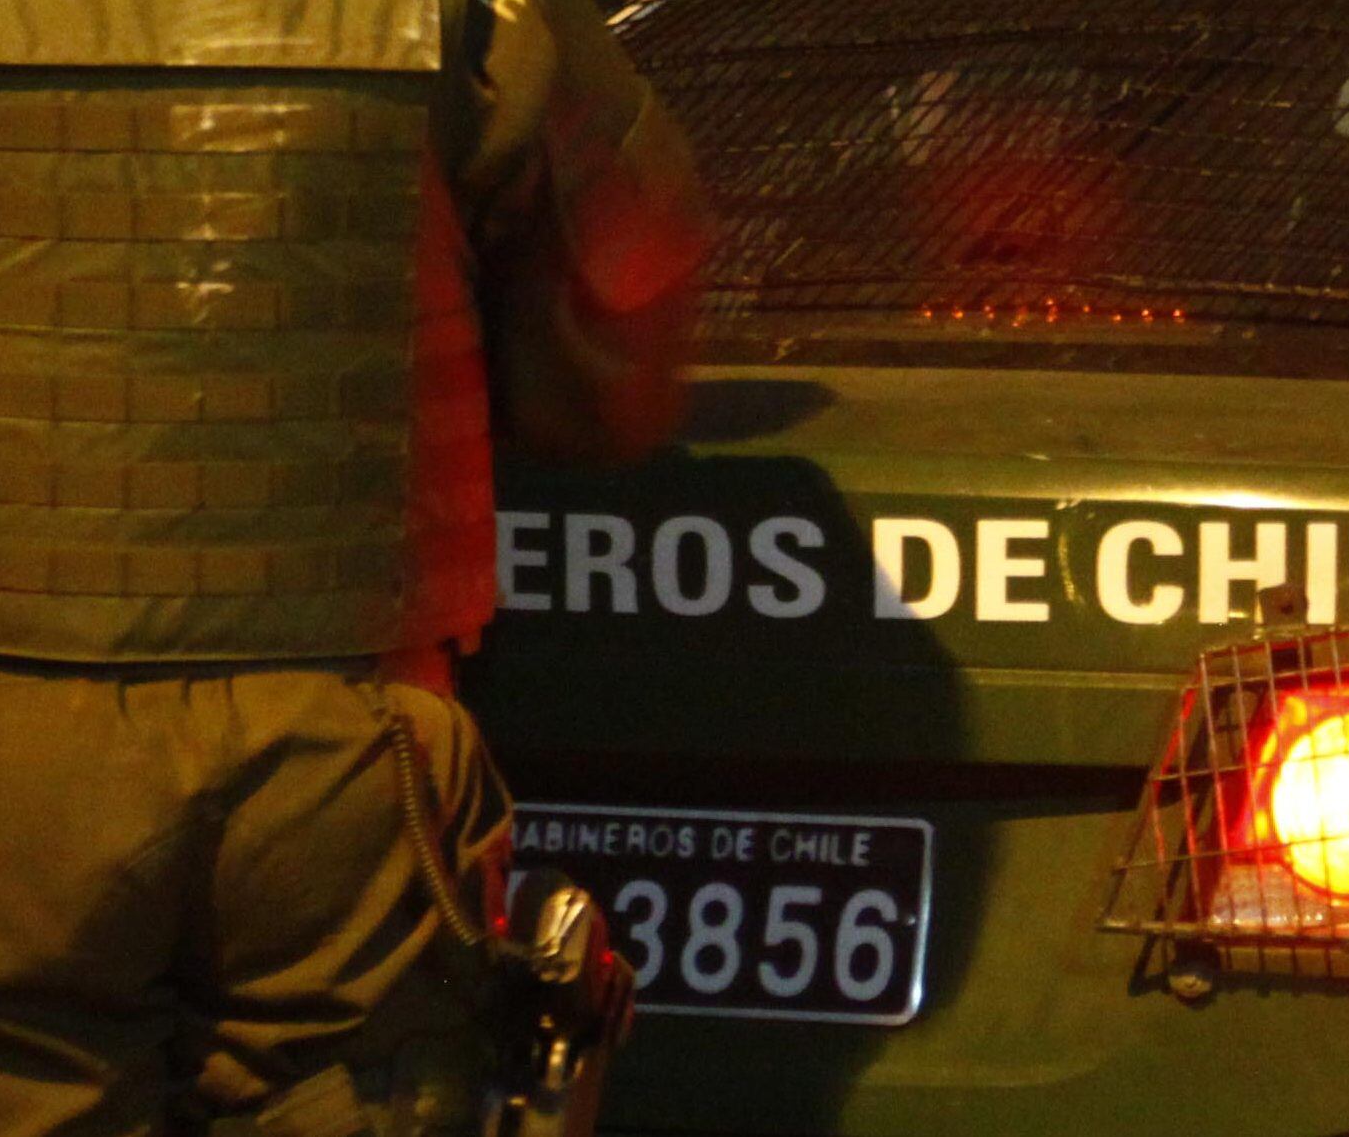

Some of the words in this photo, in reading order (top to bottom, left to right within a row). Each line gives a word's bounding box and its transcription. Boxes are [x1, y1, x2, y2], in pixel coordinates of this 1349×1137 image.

[495, 510, 827, 619] EROS
[874, 518, 1049, 623] DE
[710, 831, 754, 862] DE
[769, 830, 877, 866] CHILE
